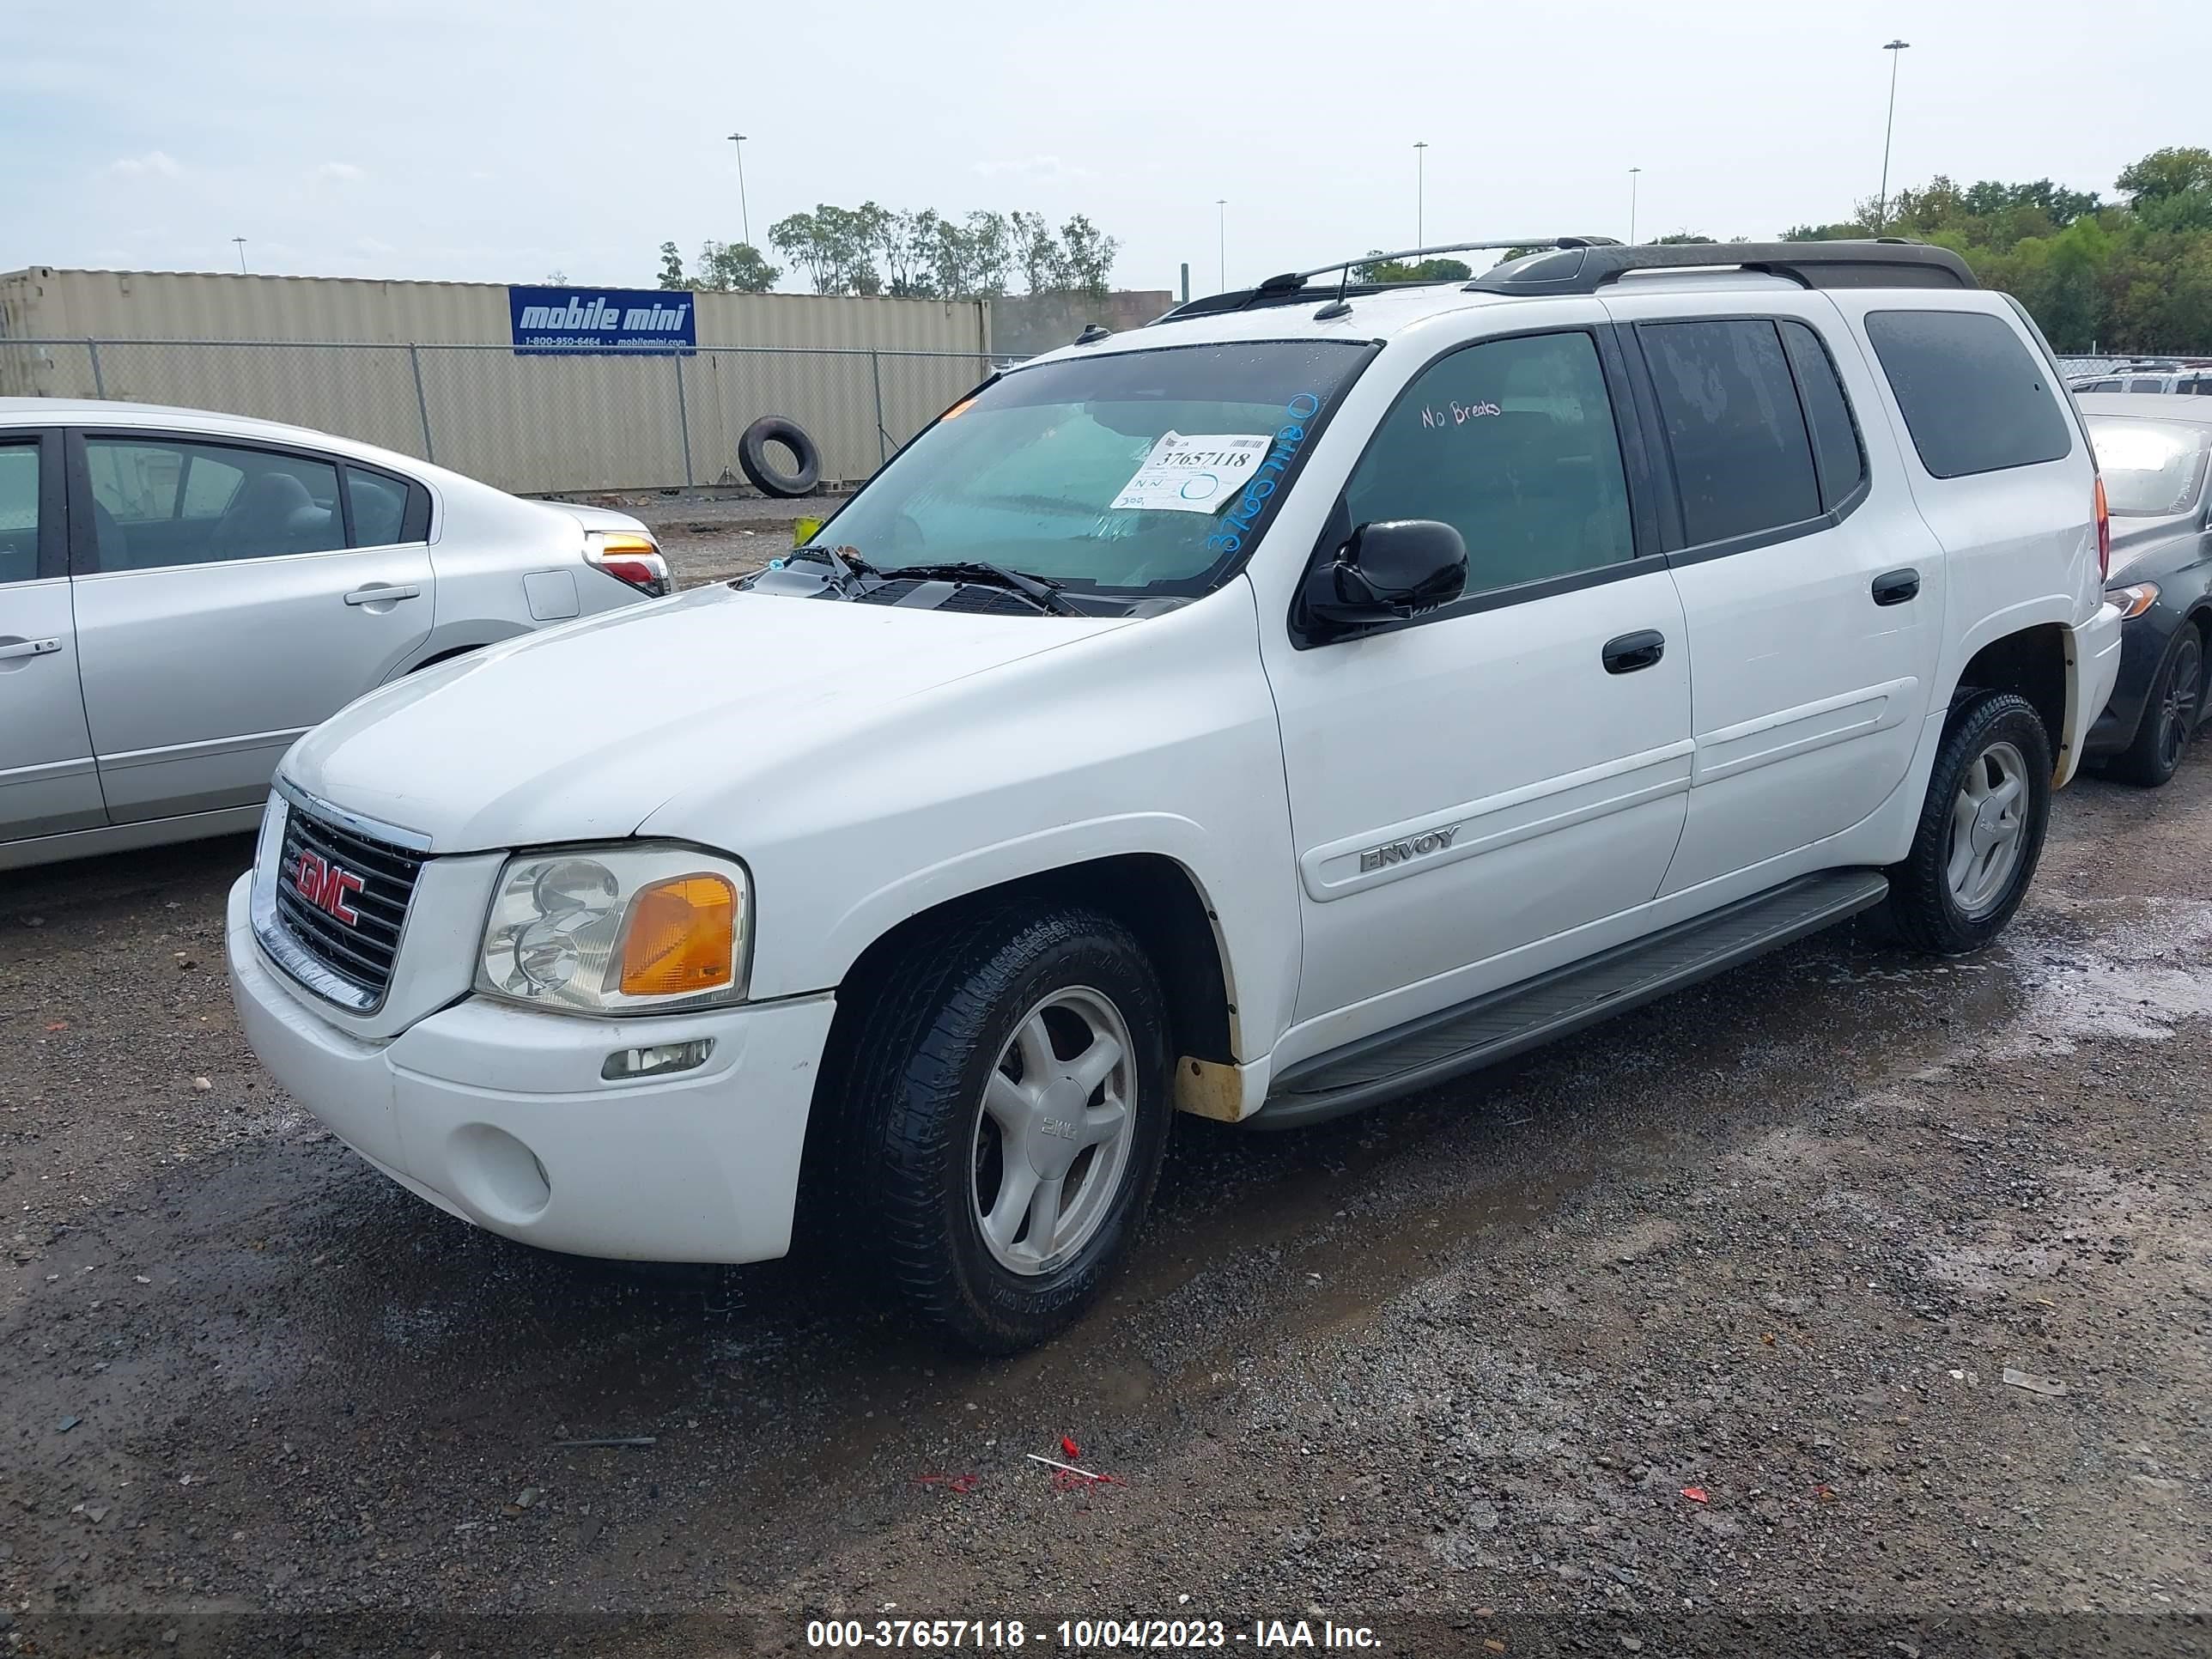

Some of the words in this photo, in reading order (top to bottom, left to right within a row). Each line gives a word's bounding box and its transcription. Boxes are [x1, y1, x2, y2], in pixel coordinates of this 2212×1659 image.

[520, 296, 619, 330] mobile
[525, 337, 600, 345] 1-800-950-6464
[617, 337, 686, 347] mobilemini.com
[1421, 404, 1444, 428] No
[1449, 400, 1501, 425] Breaks
[1156, 452, 1251, 467] 37657118
[1360, 824, 1461, 872] ENVOY
[297, 848, 365, 927] GMC
